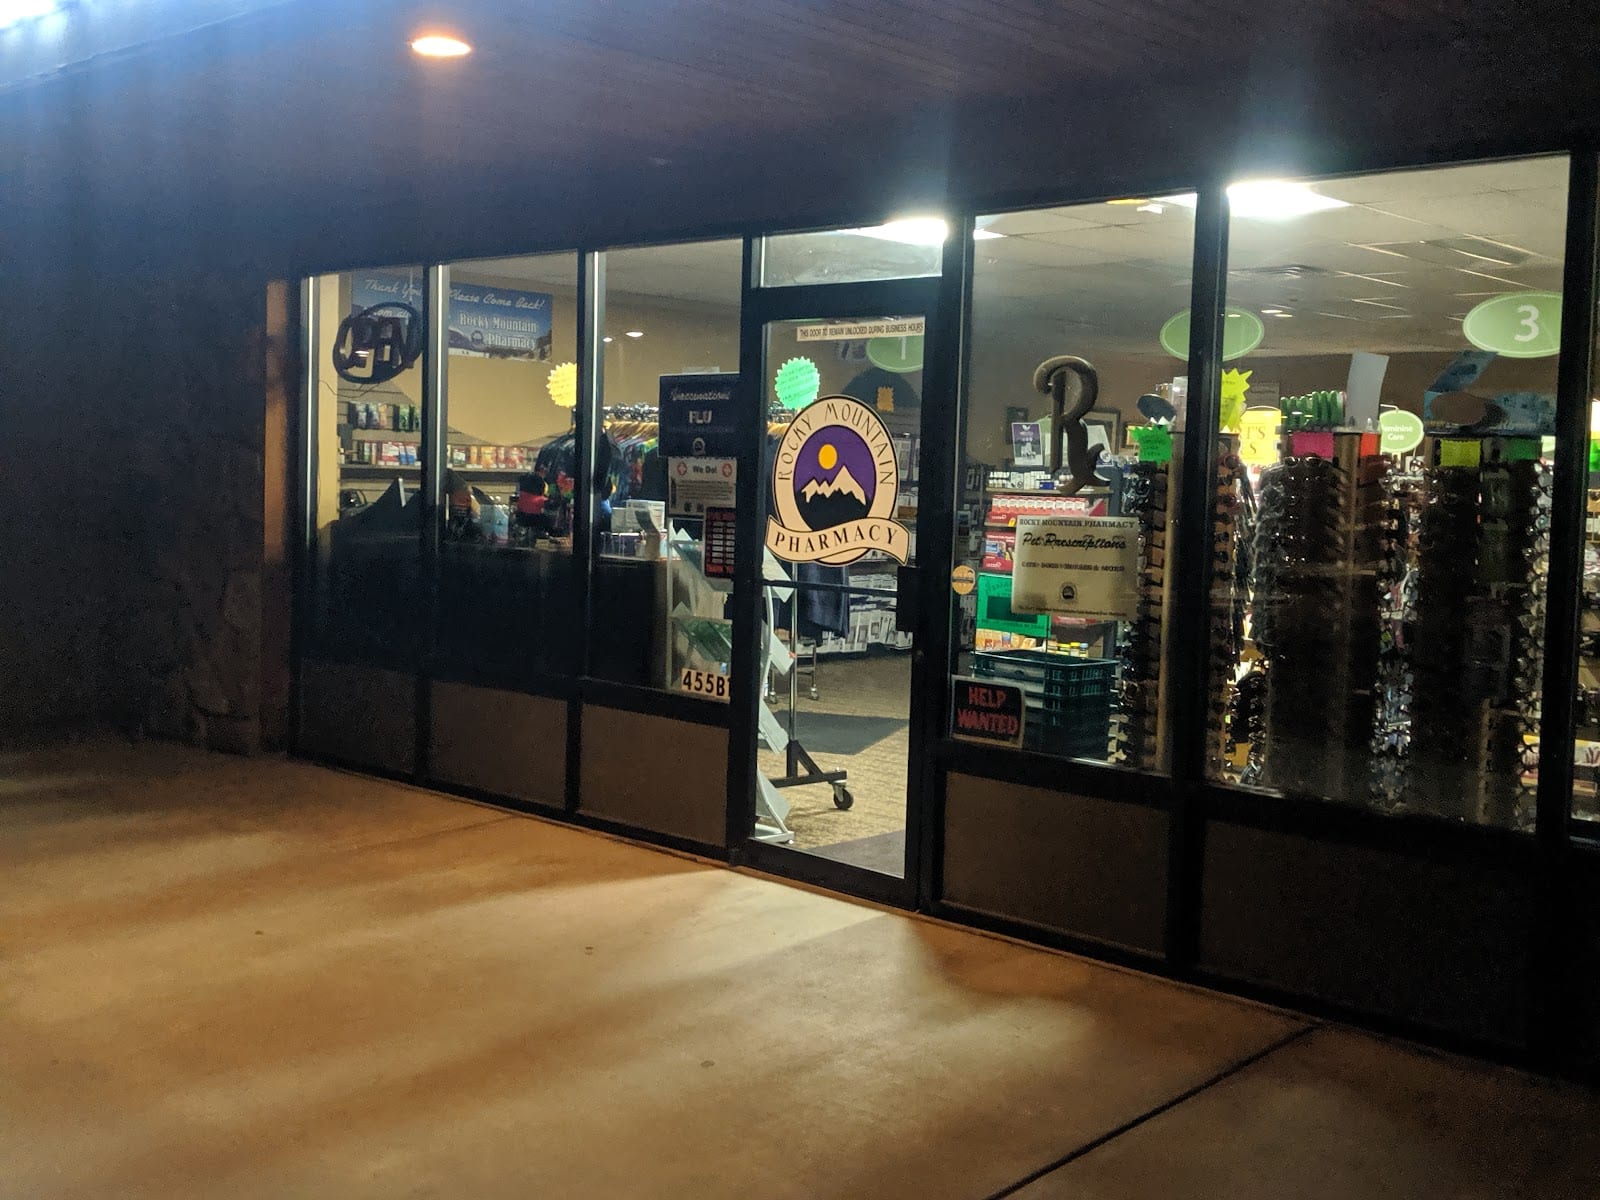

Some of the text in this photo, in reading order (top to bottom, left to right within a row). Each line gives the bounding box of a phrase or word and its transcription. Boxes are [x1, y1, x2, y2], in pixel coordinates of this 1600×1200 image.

[364, 279, 399, 294] Thank
[483, 293, 512, 306] Come
[459, 312, 537, 333] Rocky Mountain
[800, 328, 809, 338] THIS
[810, 328, 821, 338] DOOR
[829, 327, 845, 336] REMAIN
[845, 326, 868, 336] UNLOCKED
[868, 325, 885, 335] DURING
[885, 323, 907, 334] BUSINESS
[908, 321, 924, 333] HOURS
[1514, 304, 1540, 342] 3
[487, 333, 535, 351] Pharmacy
[688, 410, 713, 424] FLU
[1381, 424, 1414, 433] eminine
[778, 402, 894, 485] ROCKY MOUNTAIN
[1041, 518, 1084, 528] MOUNTAIN
[1084, 519, 1136, 529] PHARMACY
[774, 524, 898, 552] PHARMACY
[1022, 532, 1041, 546] Pet
[1044, 532, 1127, 550] Prescriptions
[968, 686, 1007, 709] HELP
[957, 707, 1019, 735] WANTED
